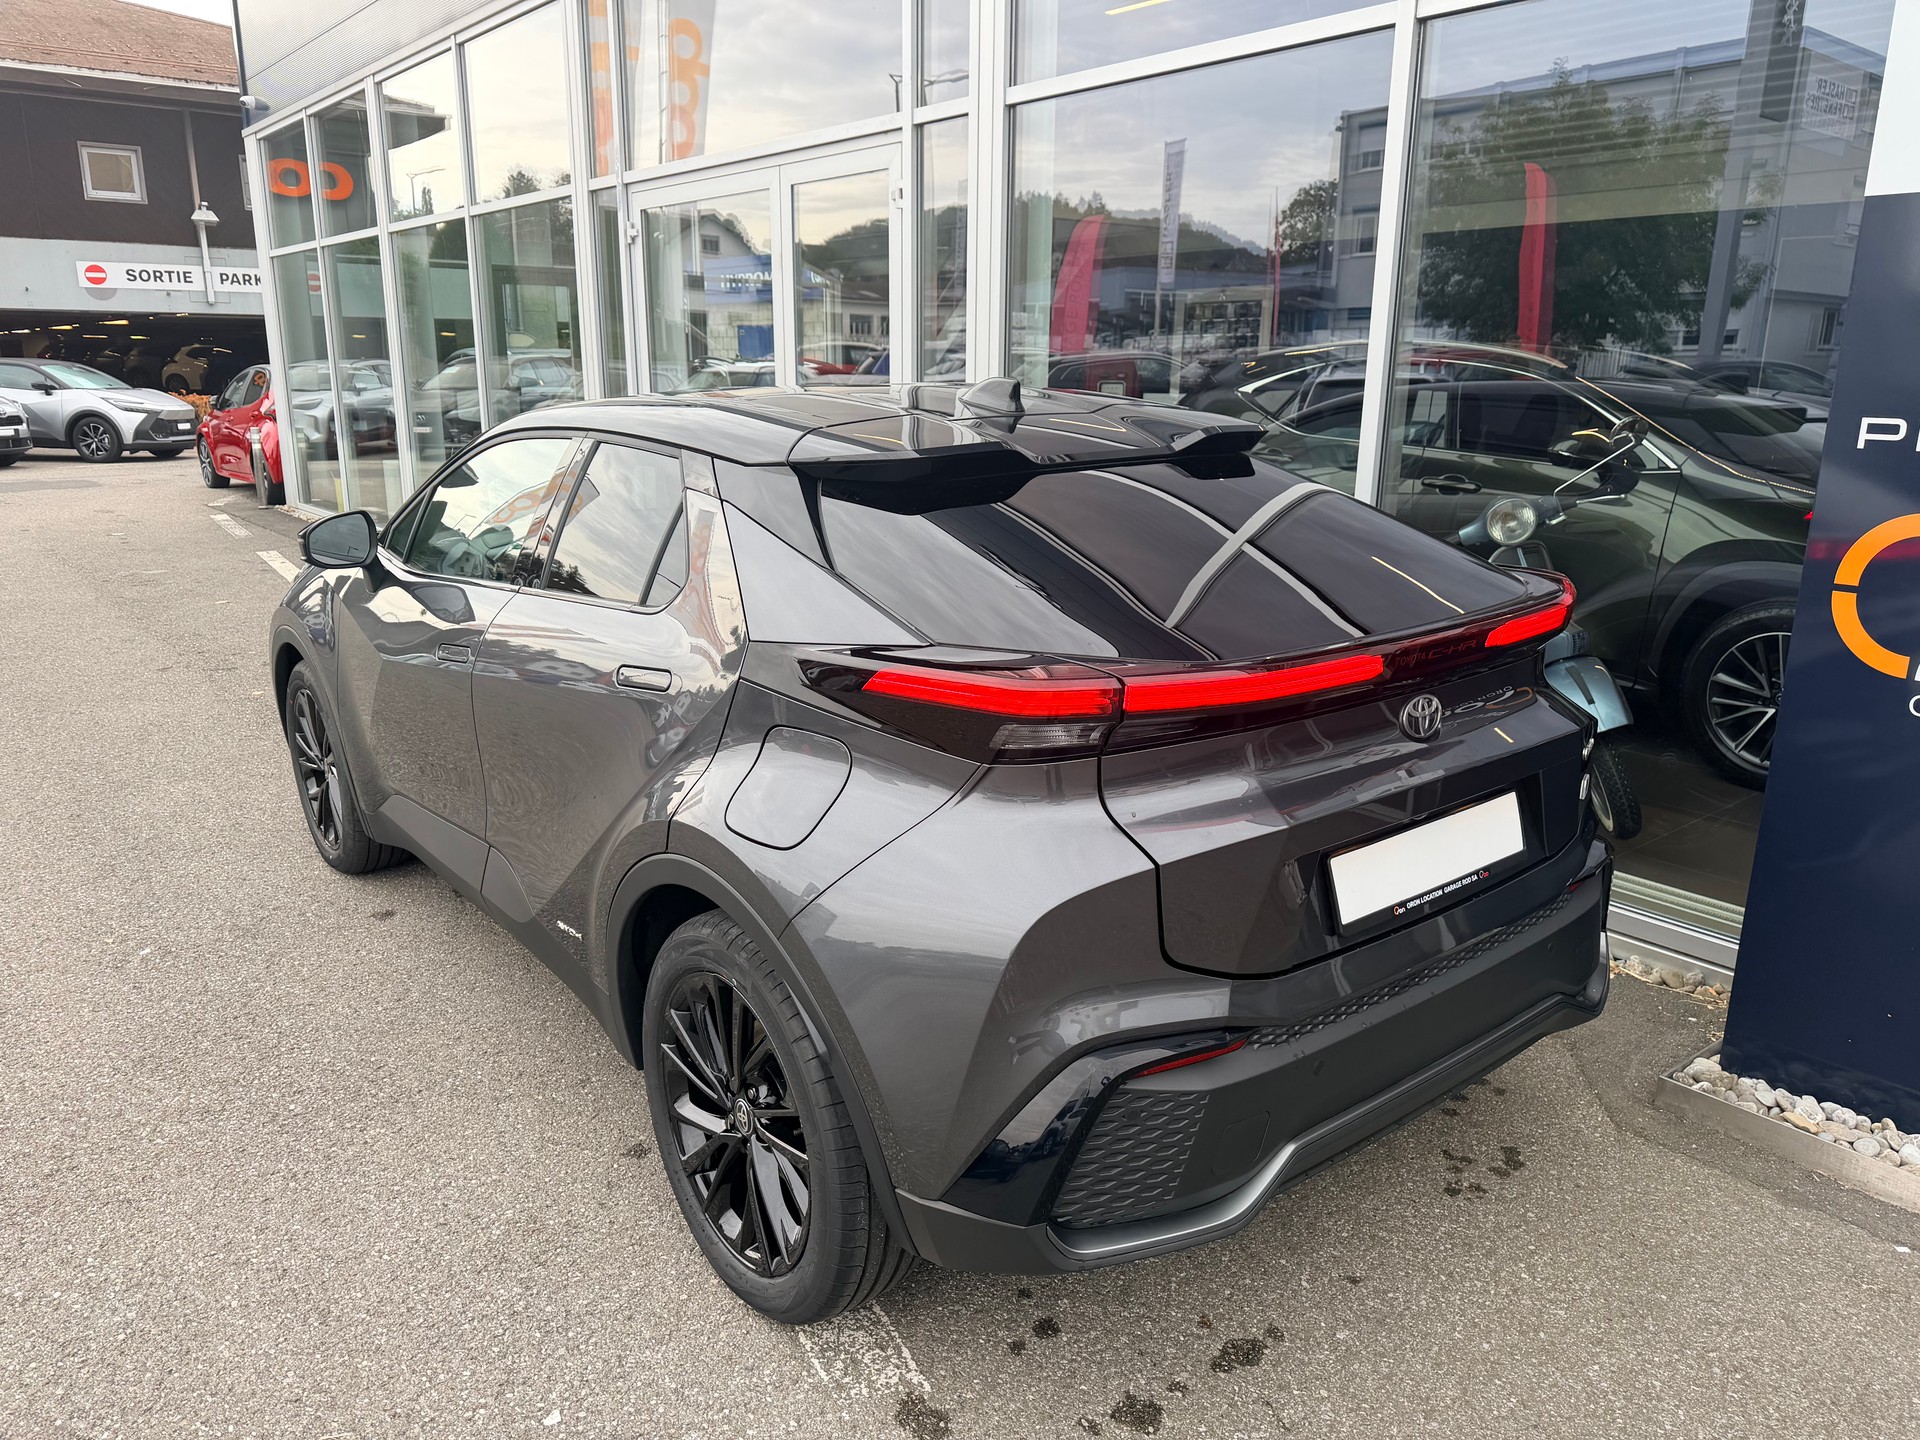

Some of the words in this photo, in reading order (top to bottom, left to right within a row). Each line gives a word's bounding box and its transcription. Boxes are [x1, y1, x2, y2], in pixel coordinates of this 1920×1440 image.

[126, 269, 193, 283] SORTIE
[1395, 651, 1426, 666] TOYOTA
[1428, 640, 1477, 660] C-HR
[1406, 898, 1421, 909] ORON
[1420, 889, 1443, 903] LOCATION
[1443, 880, 1462, 894] GARAGE
[1461, 876, 1472, 886] ROD
[1471, 873, 1478, 882] SA
